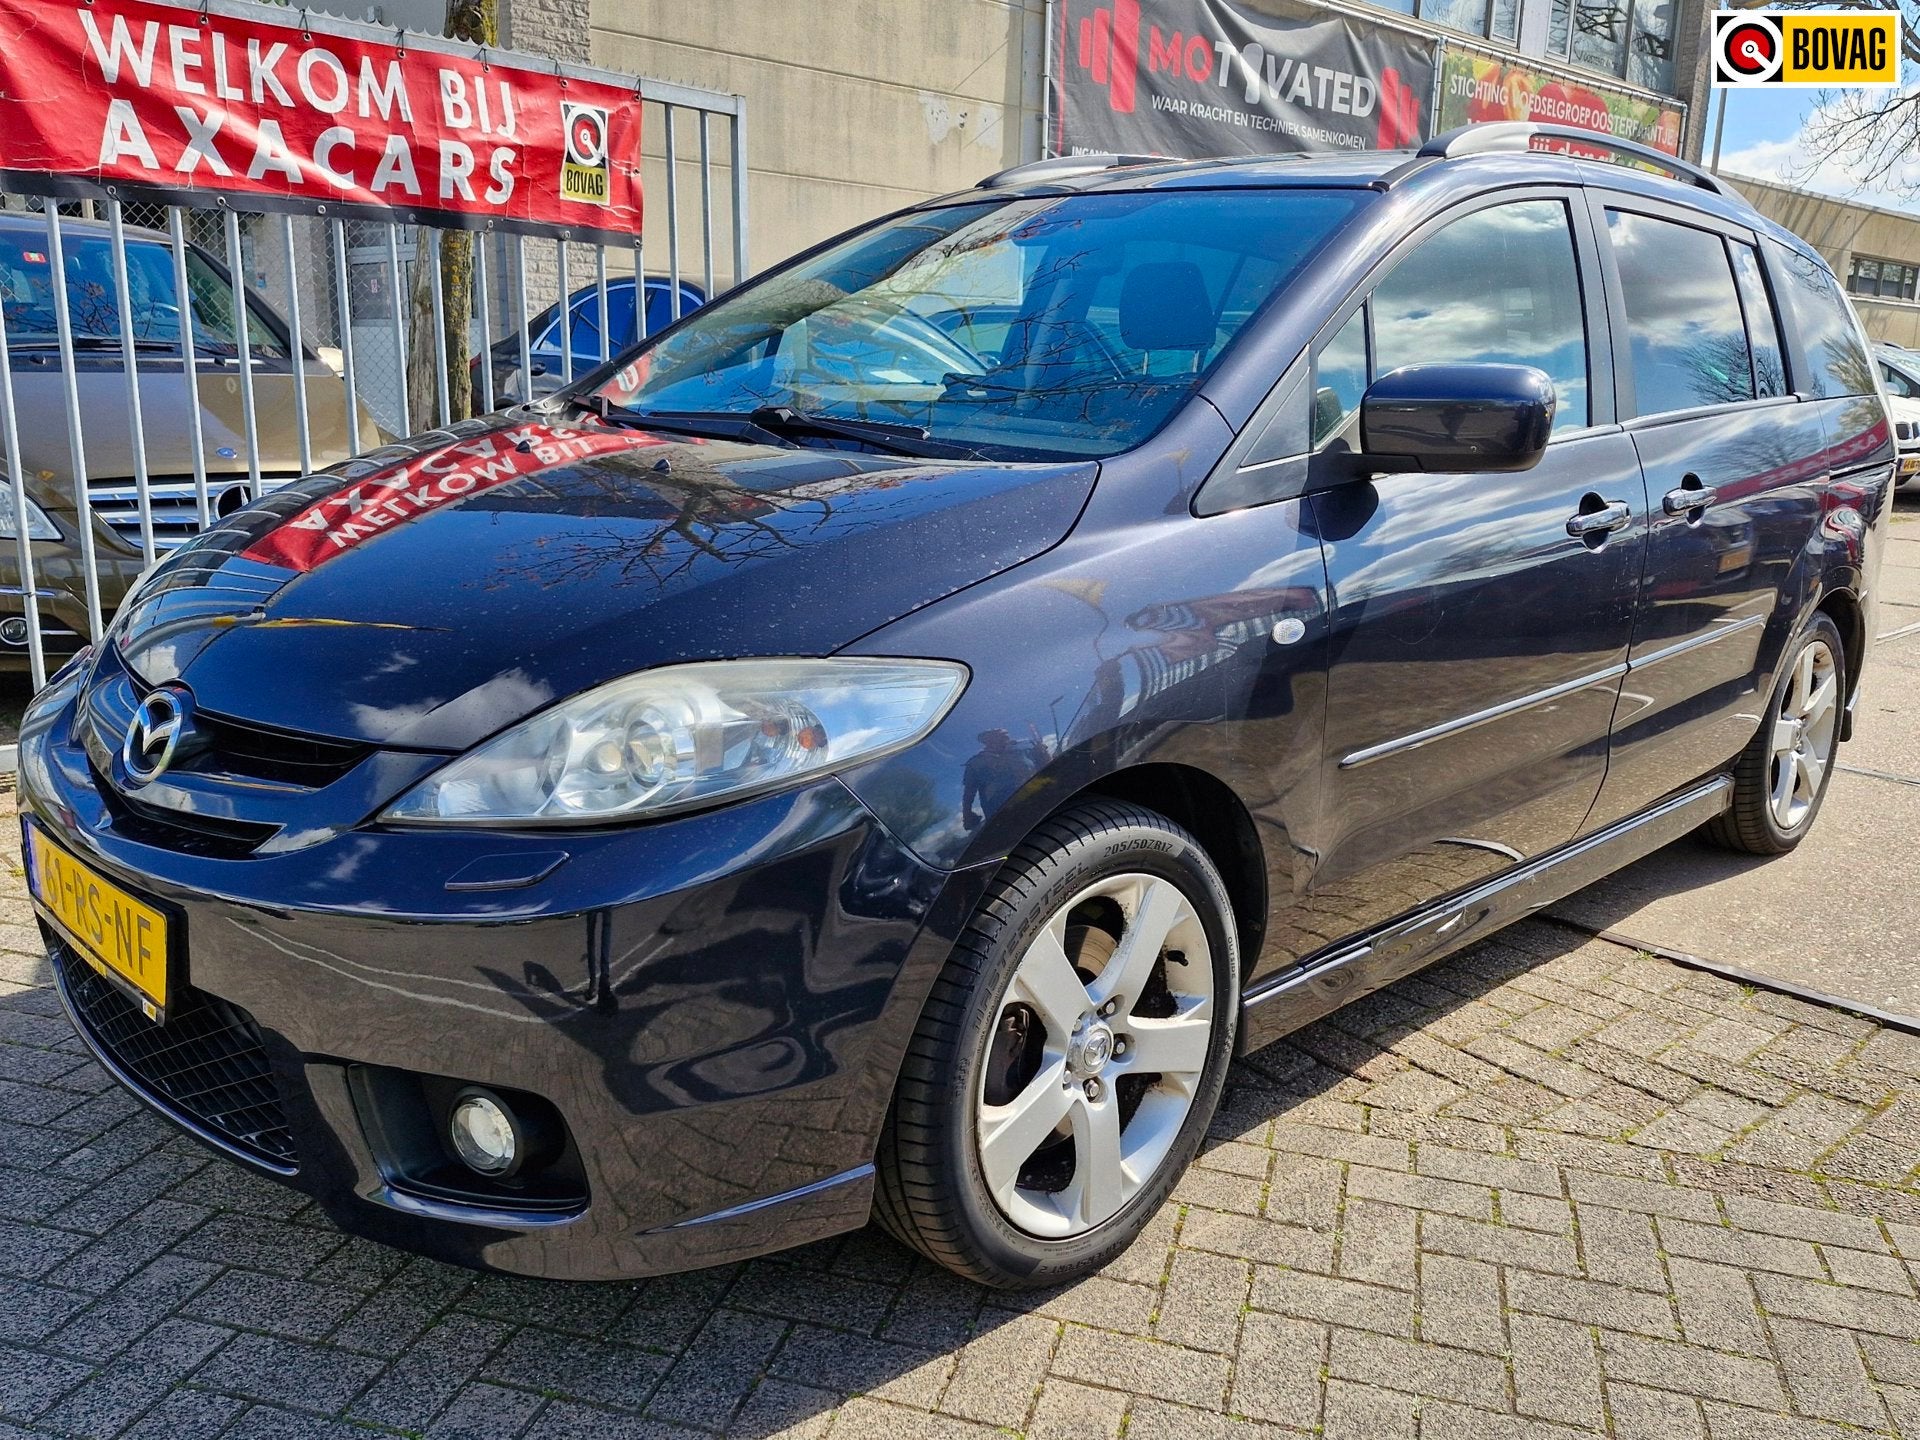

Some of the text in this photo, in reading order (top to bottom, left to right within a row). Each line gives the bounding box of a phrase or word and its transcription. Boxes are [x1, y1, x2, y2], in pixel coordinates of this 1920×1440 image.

[77, 8, 517, 138] WELKOM BIJ
[1449, 75, 1508, 105] STICHTING
[1151, 95, 1366, 150] WAAR KRACHT EN TECHNIEK SAMENKOMEN
[99, 99, 517, 205] AXACARS
[566, 169, 604, 196] BOVAG
[1103, 838, 1174, 858] 205/50ZR17
[45, 848, 151, 976] 61-RS-NF
[1227, 936, 1237, 980] OUTSIDE
